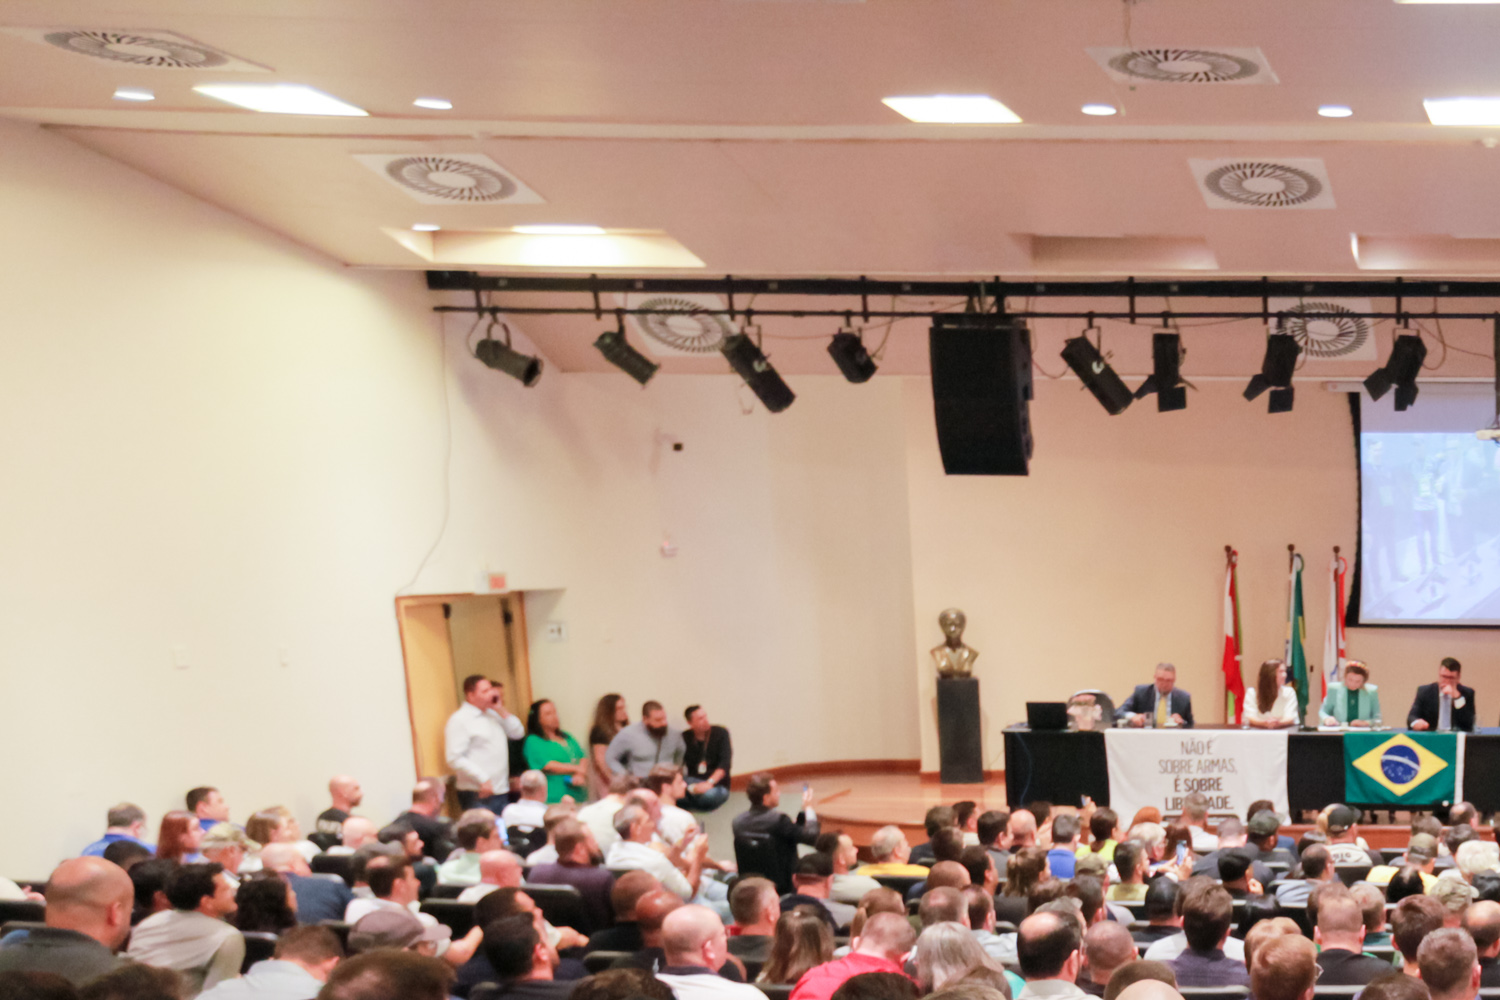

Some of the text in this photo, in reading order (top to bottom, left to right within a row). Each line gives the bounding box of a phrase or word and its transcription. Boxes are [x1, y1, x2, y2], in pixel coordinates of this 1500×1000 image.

[1181, 738, 1214, 755] NÃO É
[1159, 758, 1238, 775] SOBRE ARMAS,
[1174, 775, 1223, 793] É SOBRE
